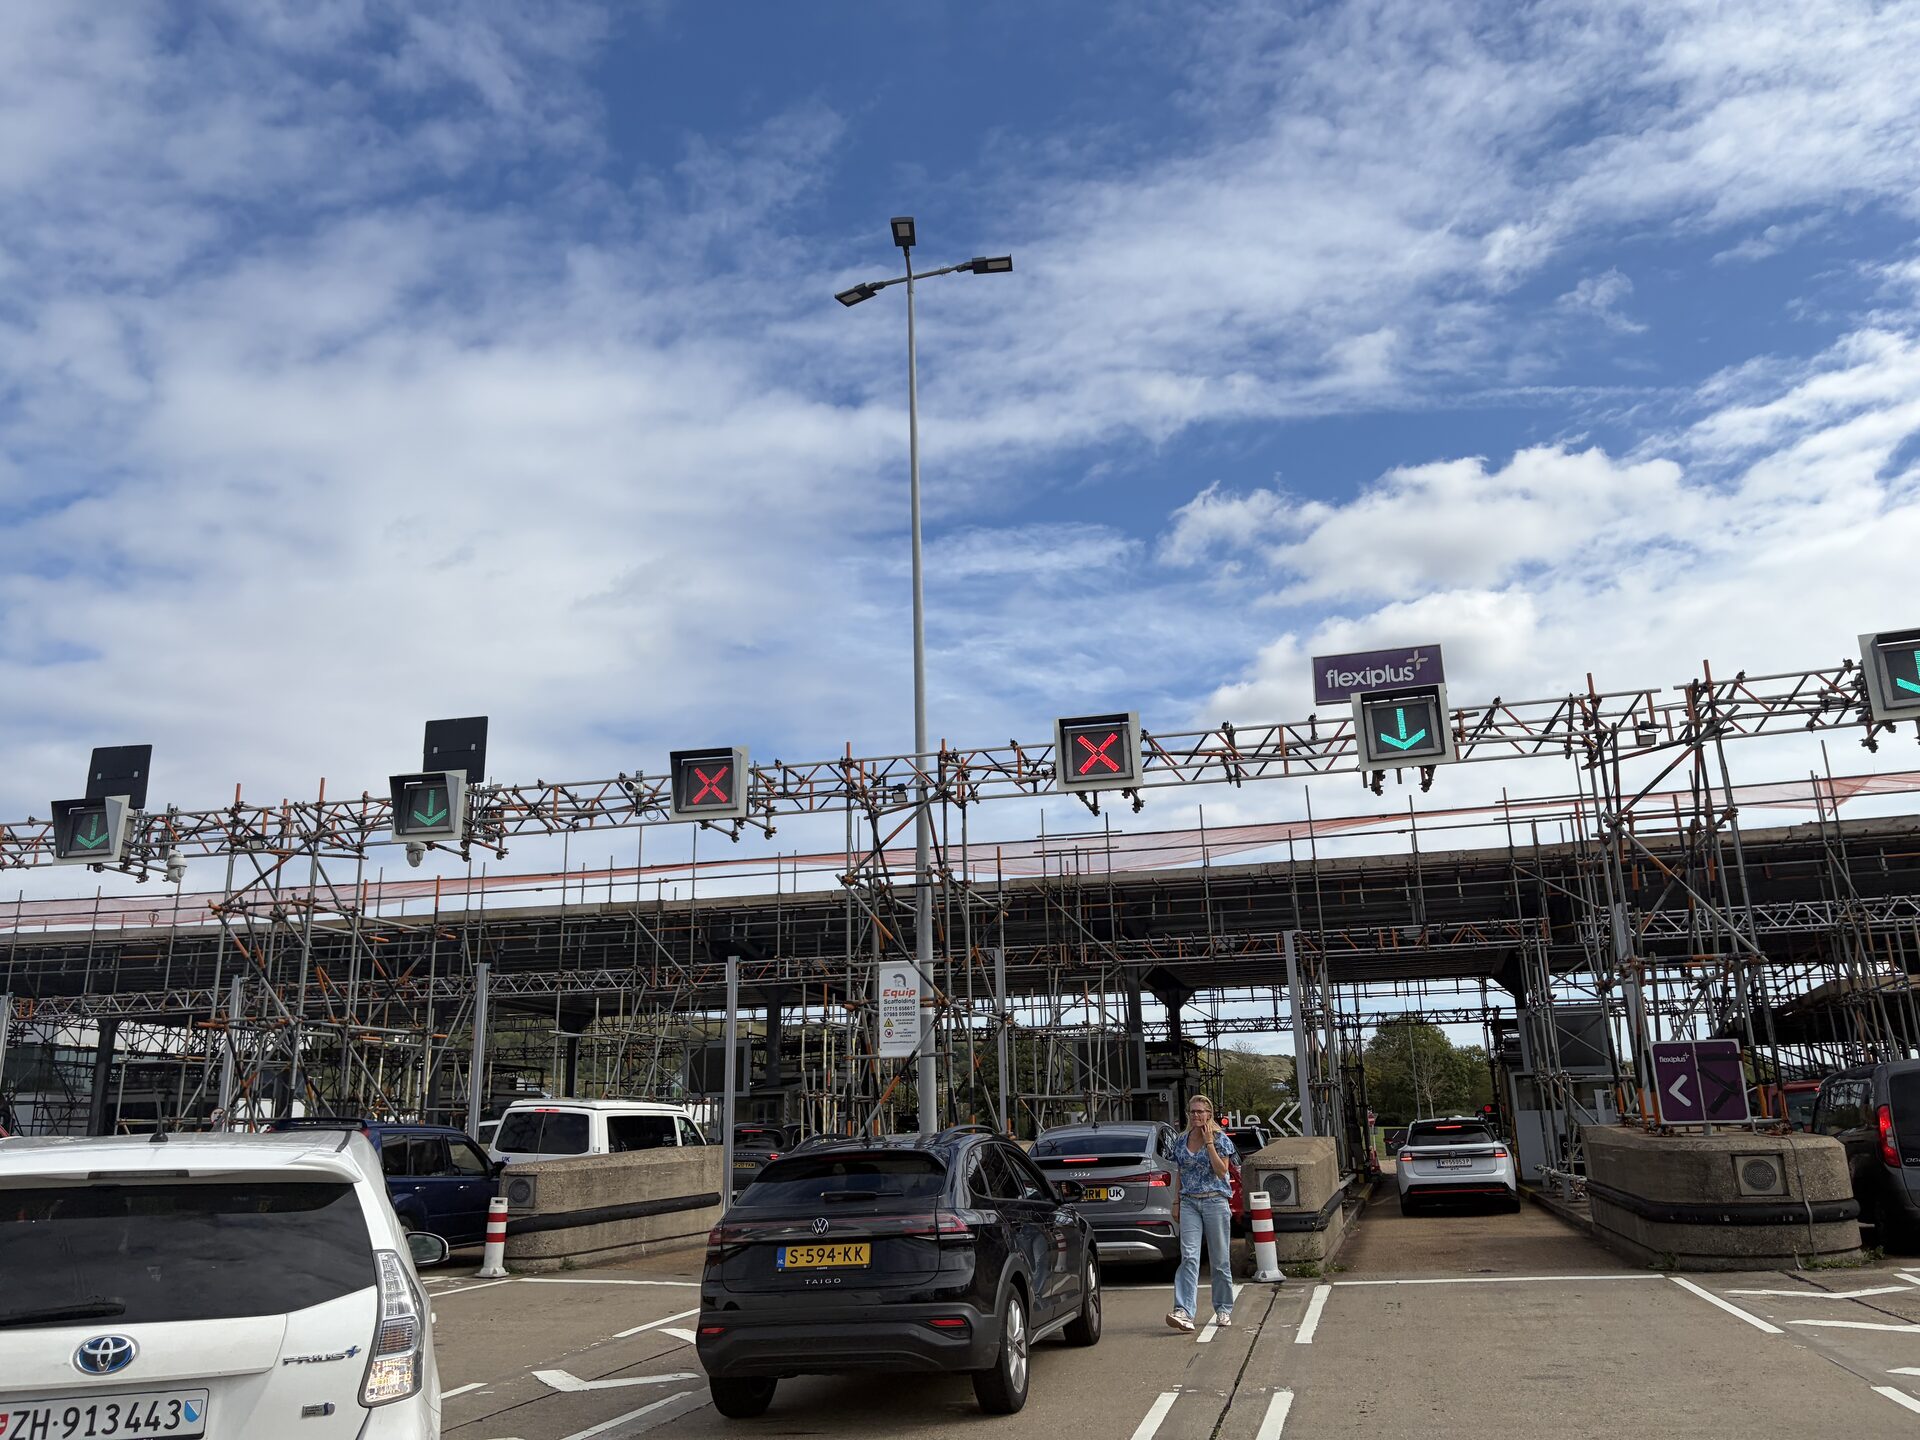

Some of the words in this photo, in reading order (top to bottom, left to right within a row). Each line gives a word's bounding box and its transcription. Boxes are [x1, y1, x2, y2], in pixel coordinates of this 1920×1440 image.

[1325, 664, 1415, 688] flexiplus
[883, 987, 916, 998] Equip
[1109, 1189, 1122, 1198] UK
[789, 1246, 864, 1264] S-594-KK
